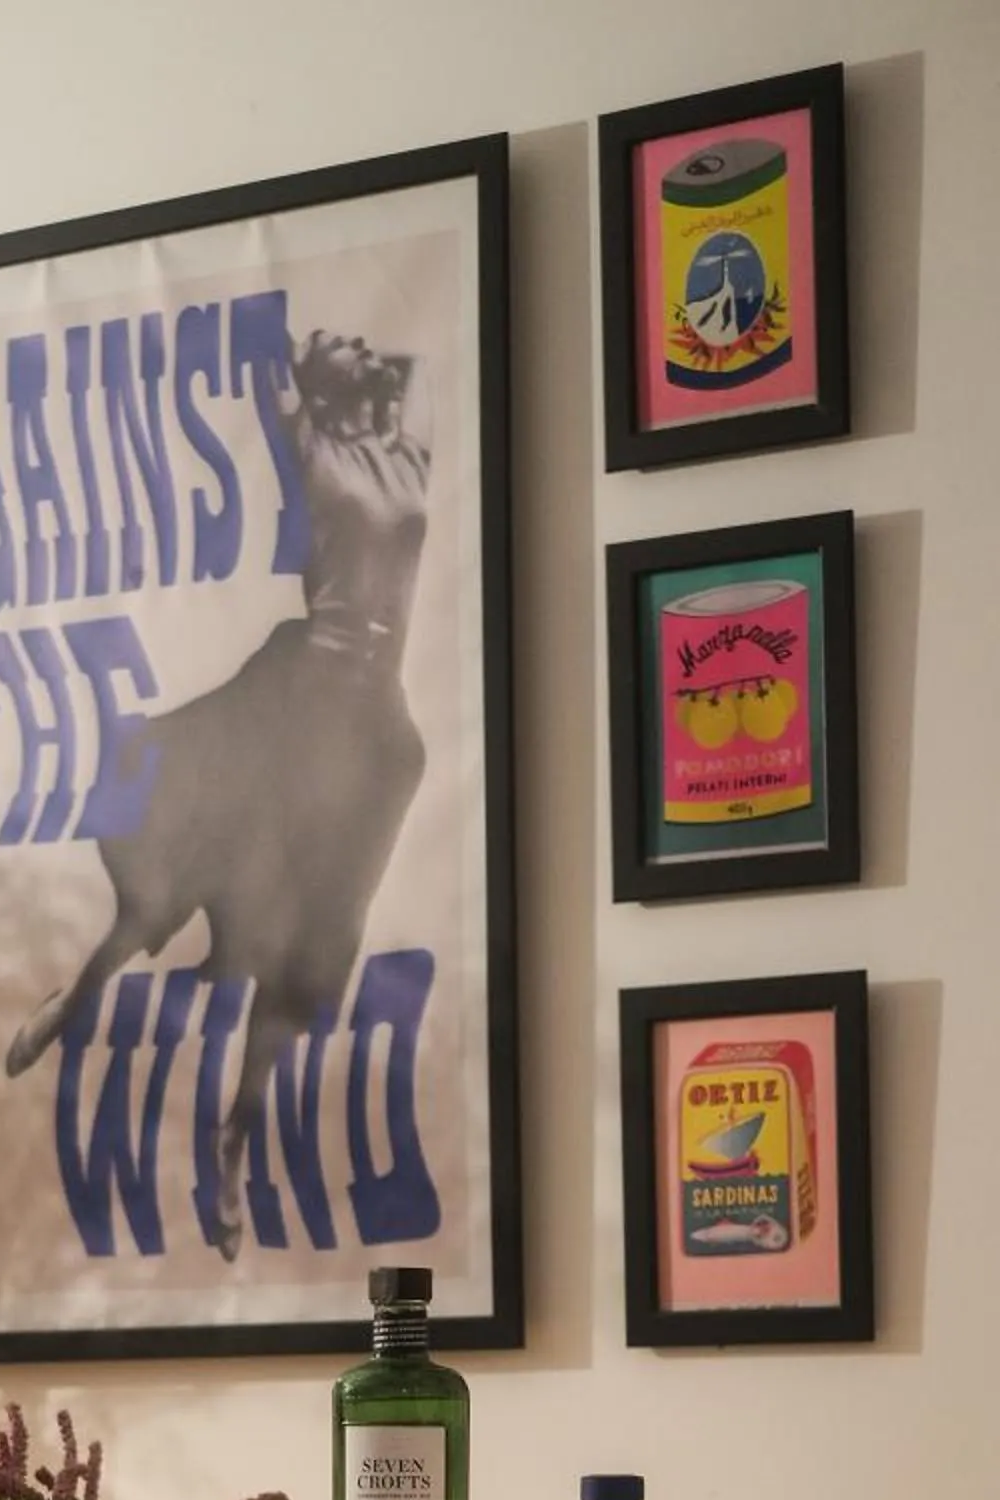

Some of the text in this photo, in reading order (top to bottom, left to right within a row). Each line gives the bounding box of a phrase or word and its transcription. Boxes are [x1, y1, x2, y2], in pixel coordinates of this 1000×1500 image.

[687, 773, 788, 795] PELATI INTERNI
[55, 948, 441, 1257] WIND
[688, 1078, 780, 1107] ORTIZ
[692, 1184, 779, 1208] SARDINAS
[362, 1458, 425, 1473] SEVEN
[357, 1474, 431, 1490] CROFTS
